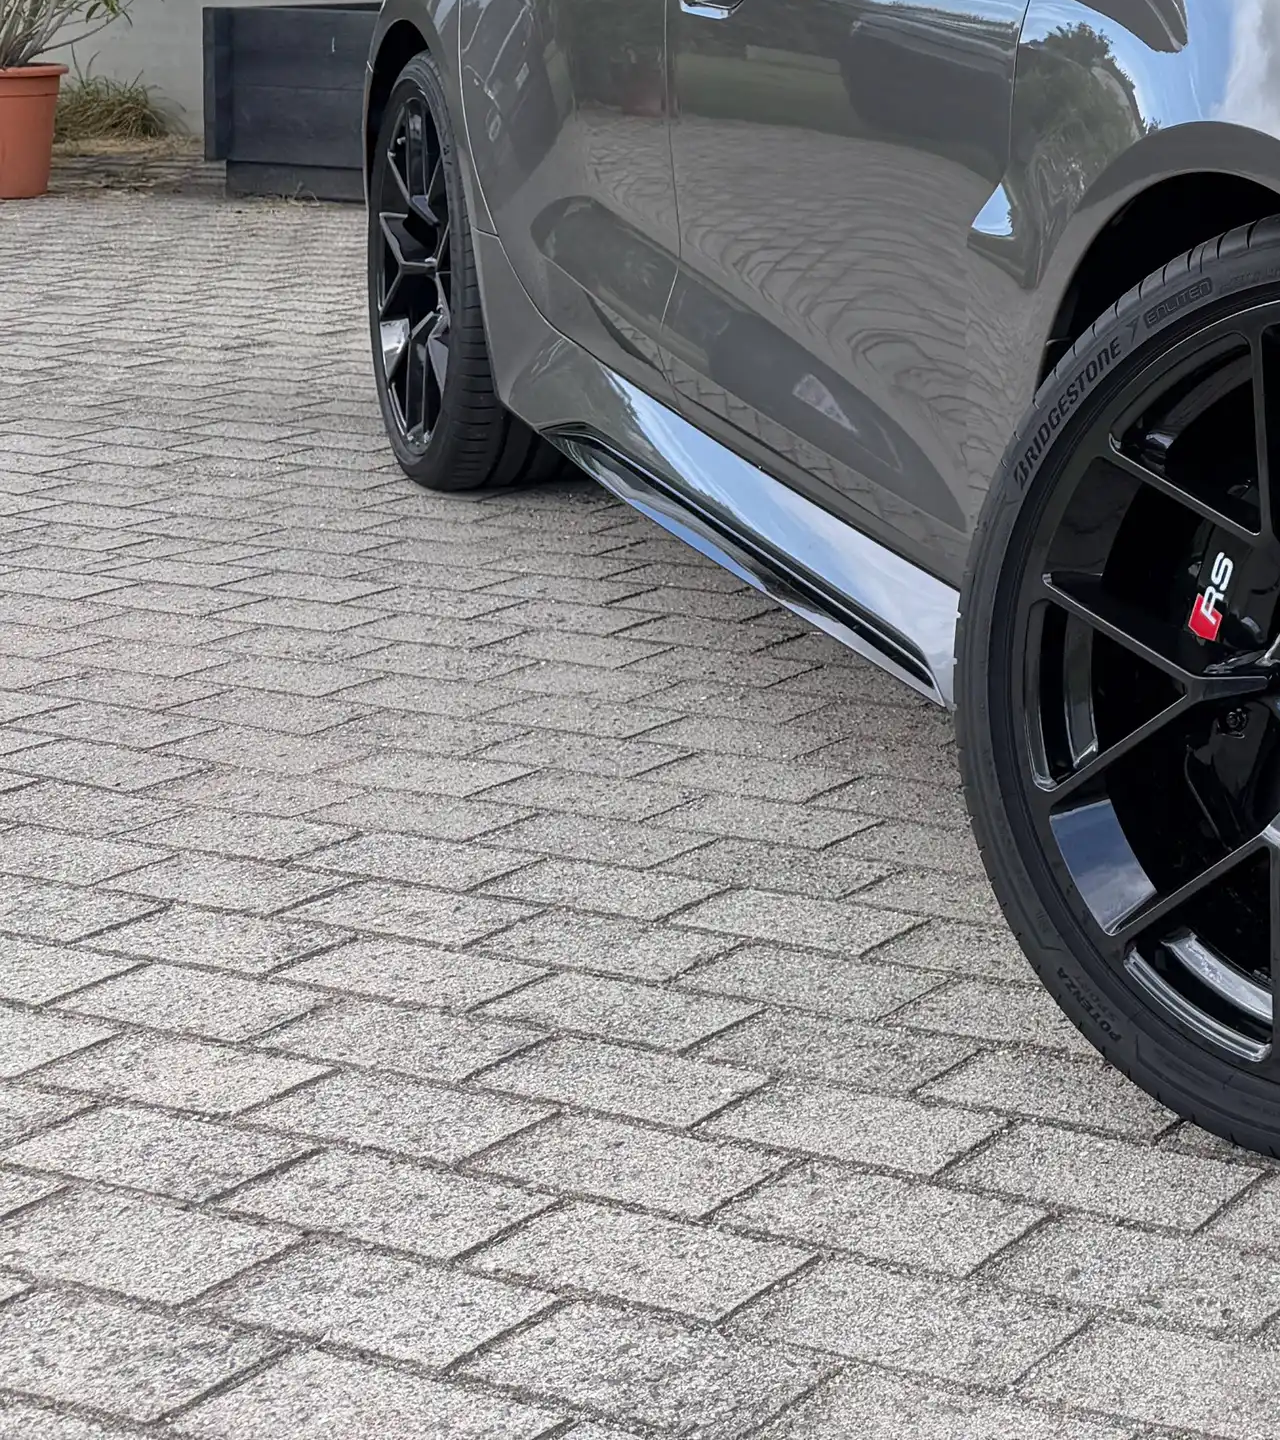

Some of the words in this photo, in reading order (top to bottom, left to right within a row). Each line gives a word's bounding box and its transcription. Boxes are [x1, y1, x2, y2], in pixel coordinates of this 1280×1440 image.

[1013, 336, 1122, 491] BRIDGESTONE
[1200, 551, 1234, 625] RS
[1057, 967, 1122, 1042] POTENZA
